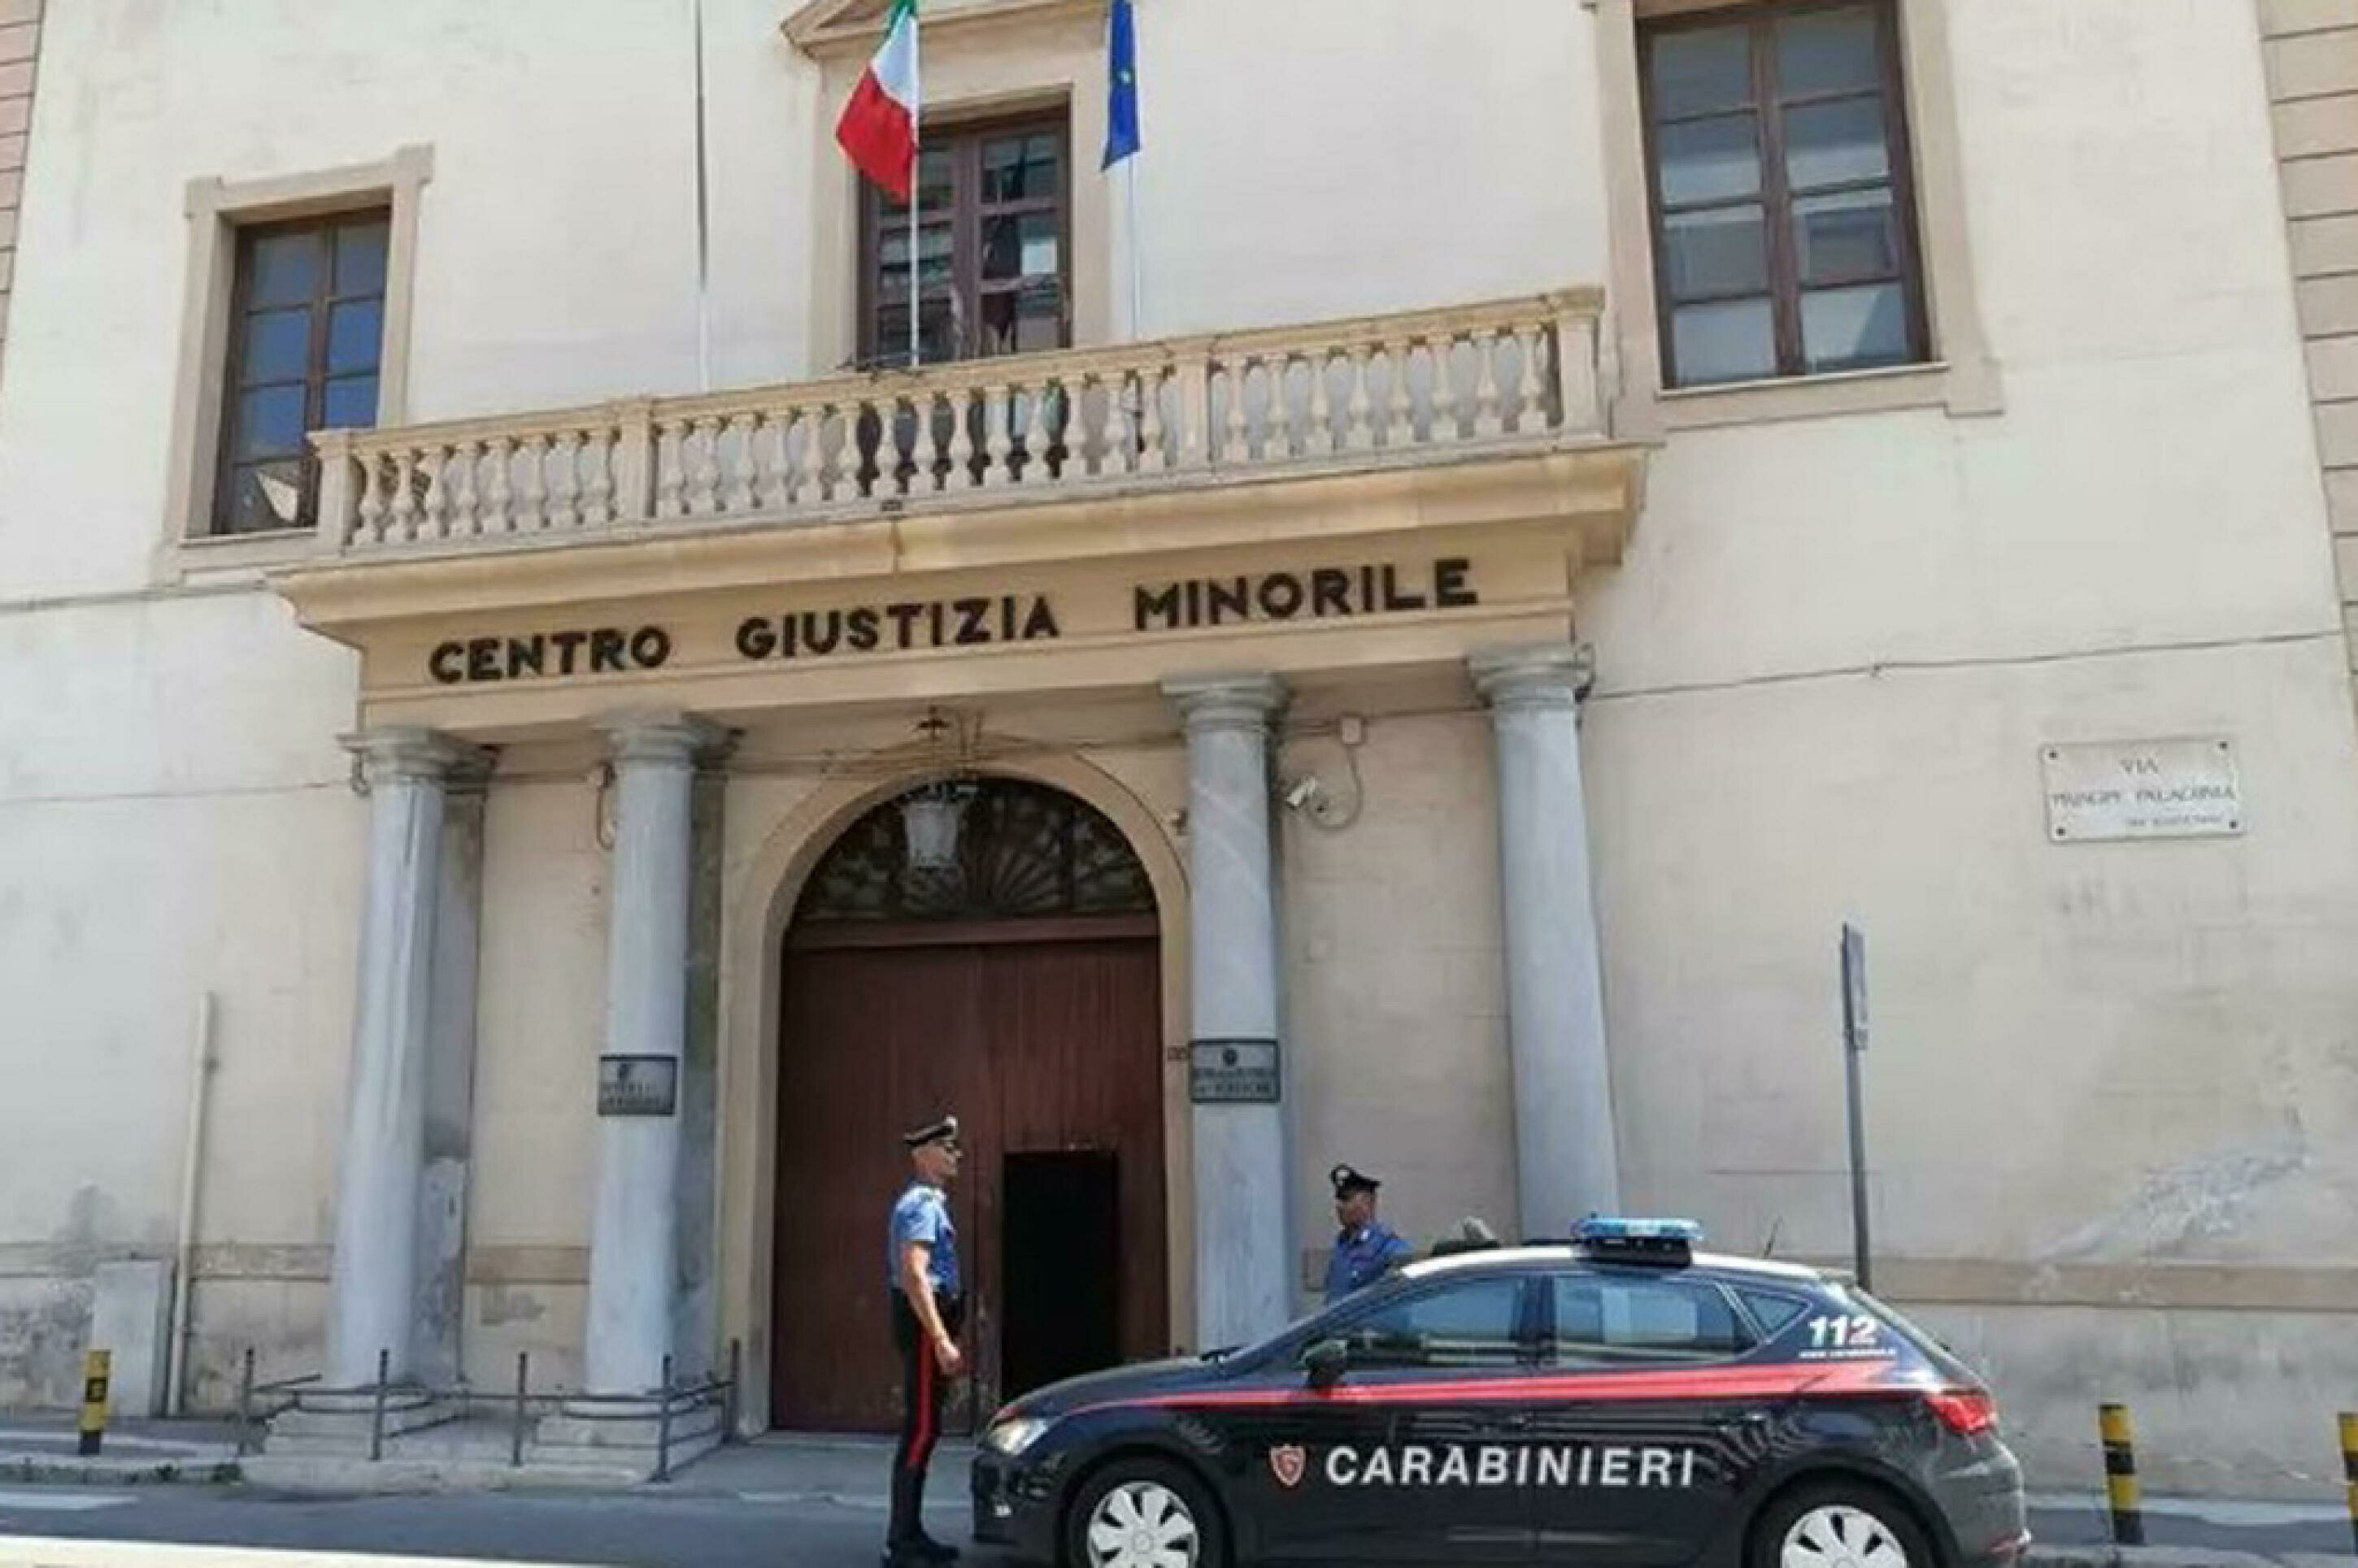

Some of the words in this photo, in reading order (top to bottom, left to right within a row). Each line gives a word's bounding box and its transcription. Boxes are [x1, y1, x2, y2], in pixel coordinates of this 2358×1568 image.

[429, 625, 672, 684] CENTRO
[734, 595, 1060, 660] GIUSTIZIA
[1133, 557, 1480, 632] MINORILE
[2119, 757, 2160, 775] VIA
[1808, 1314, 1877, 1348] 112
[1325, 1444, 1695, 1487] CARABINIERI
